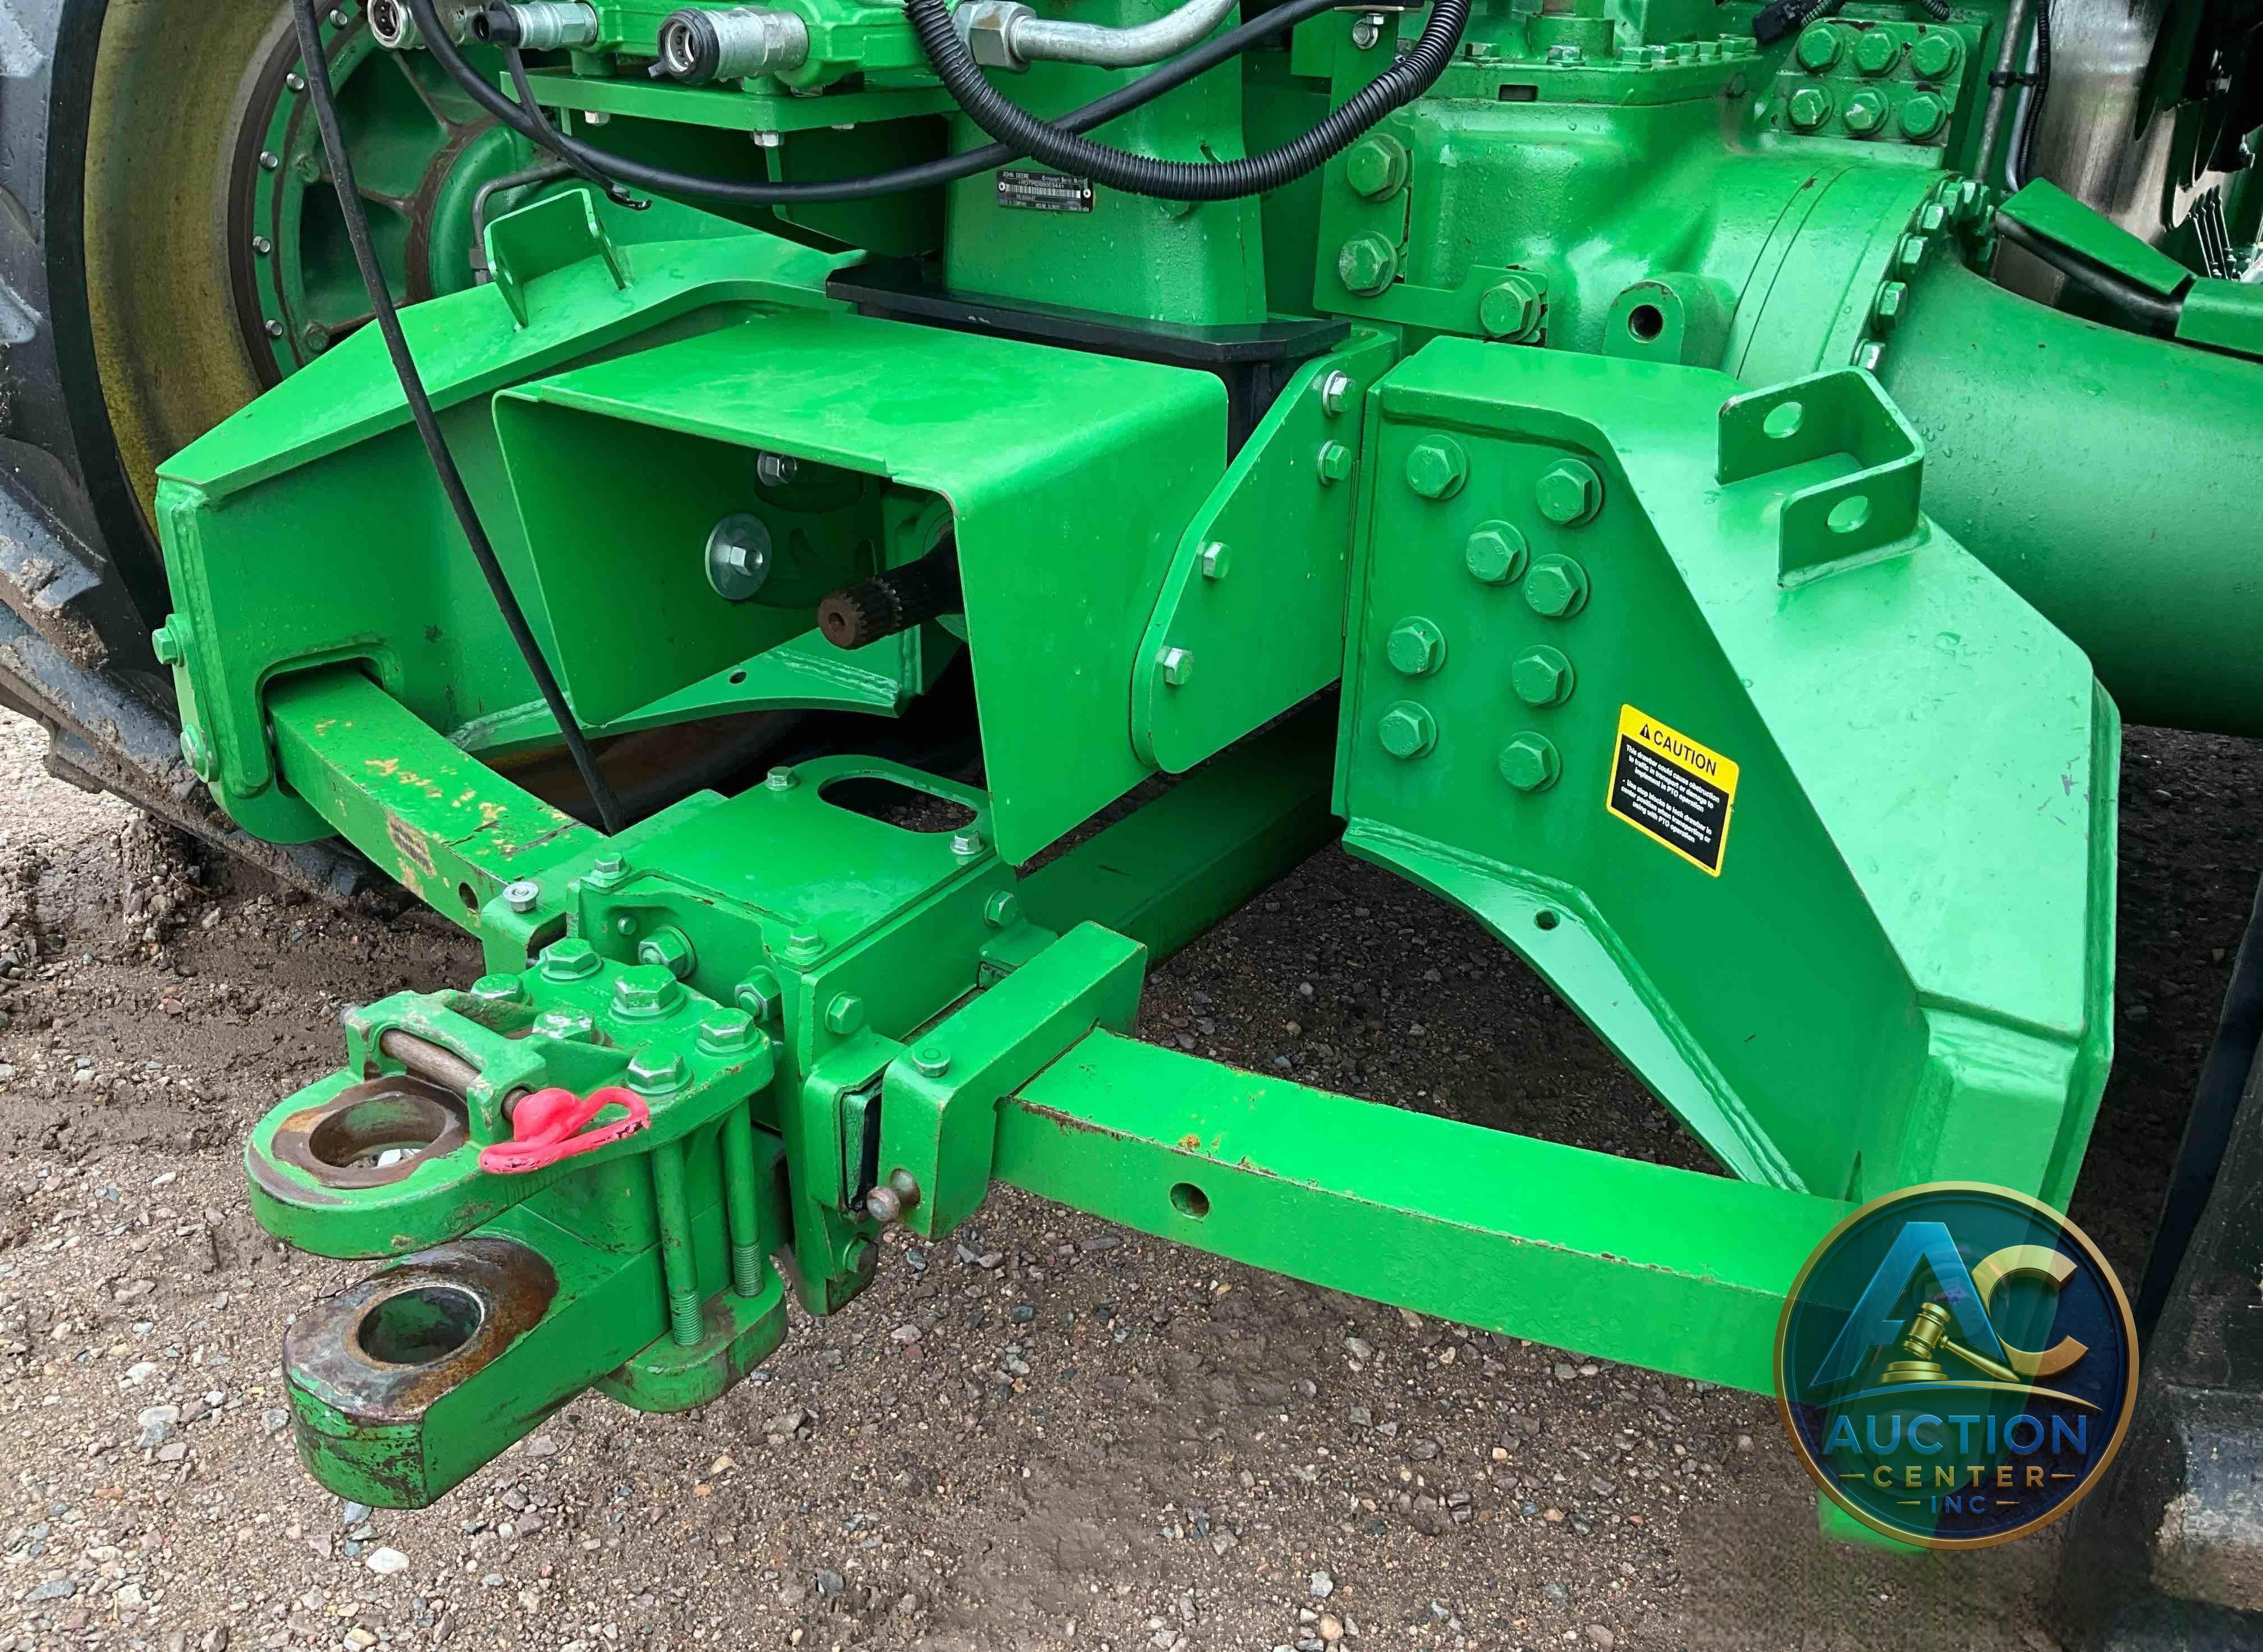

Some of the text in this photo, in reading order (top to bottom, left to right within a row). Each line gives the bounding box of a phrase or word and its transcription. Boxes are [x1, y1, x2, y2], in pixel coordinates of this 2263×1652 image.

[1625, 744, 1637, 756] This
[1657, 763, 1672, 776] could
[1673, 772, 1688, 786] cause
[1689, 781, 1720, 803] obstruction
[1653, 730, 1716, 775] CAUTION
[1627, 779, 1637, 790] Use
[1666, 802, 1671, 811] to
[1672, 806, 1683, 818] lock
[1706, 827, 1712, 836] in
[1655, 770, 1678, 790] transport
[1685, 788, 1706, 806] damage
[1707, 800, 1713, 809] to
[1666, 786, 1678, 797] PTO
[1678, 793, 1704, 813] operation
[1620, 784, 1711, 843] center position when transporting or
[1647, 809, 1657, 820] with
[1658, 815, 1669, 827] PTO
[1669, 823, 1695, 845] operation
